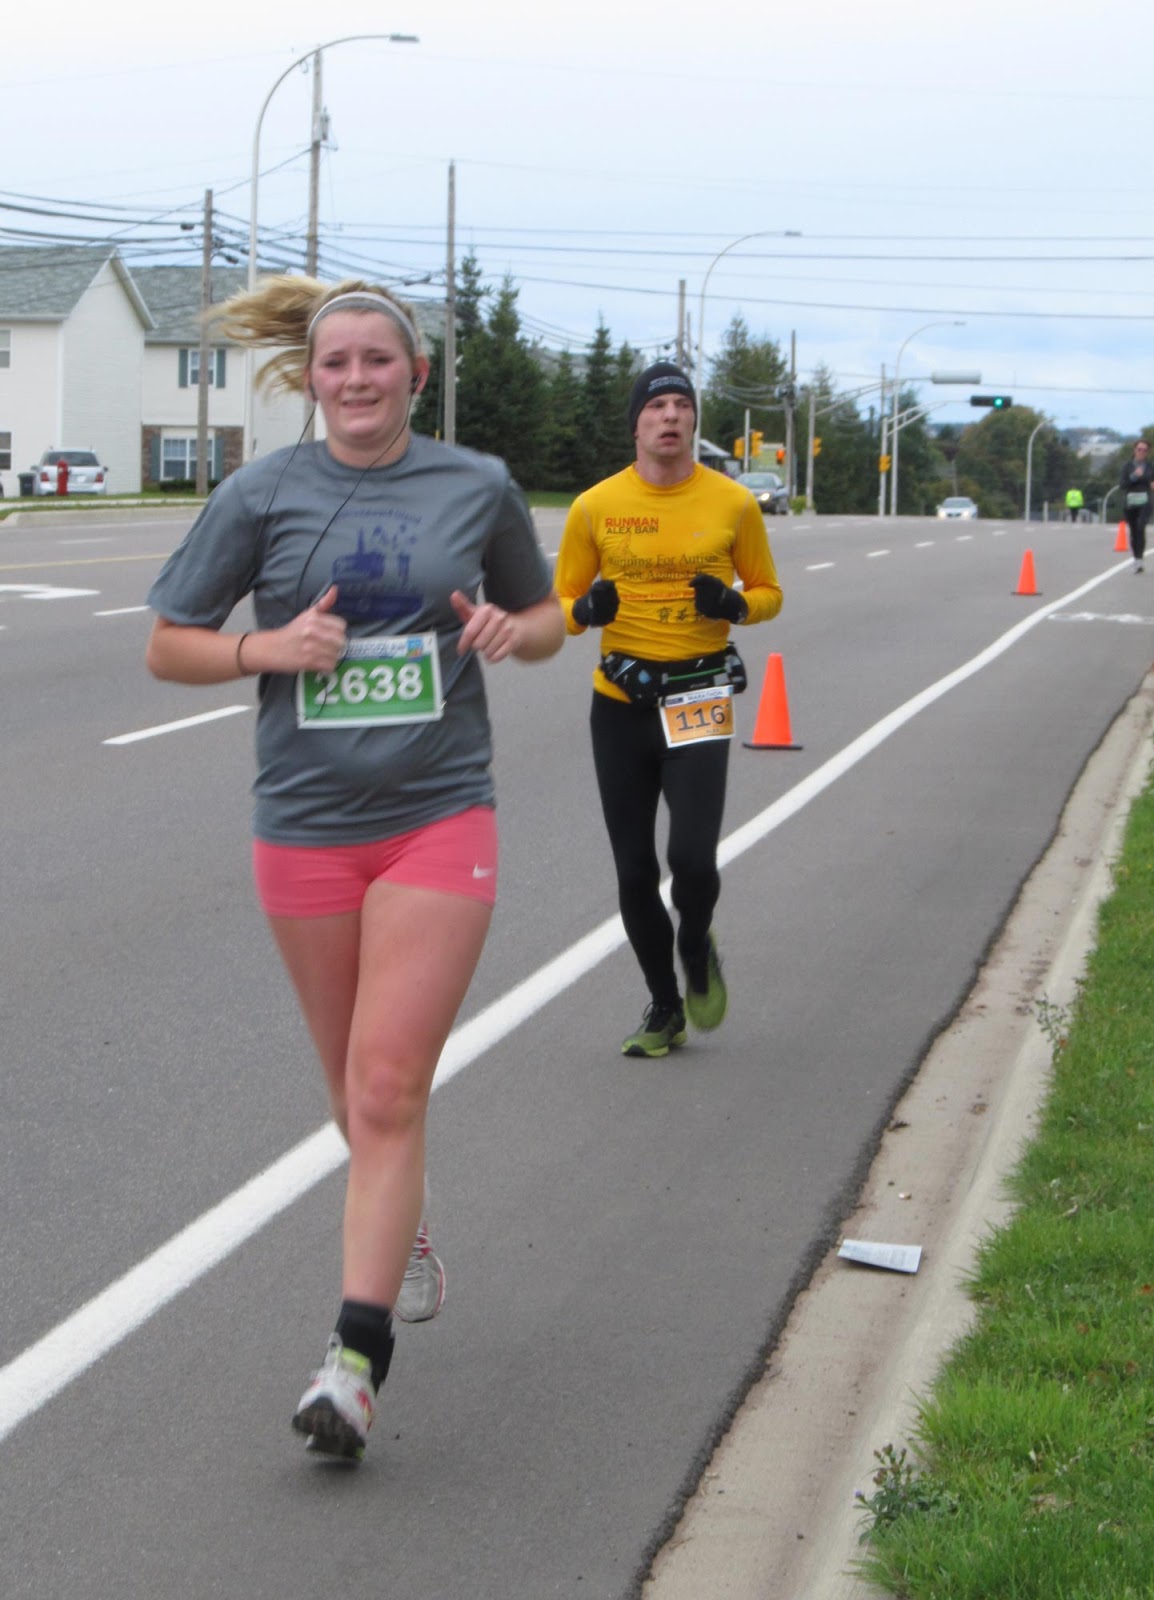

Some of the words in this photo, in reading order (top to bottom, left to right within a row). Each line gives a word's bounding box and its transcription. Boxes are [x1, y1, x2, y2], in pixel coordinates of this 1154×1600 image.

[605, 518, 659, 528] RUNMAN
[606, 527, 631, 535] ALEX
[635, 525, 658, 534] BAIN
[656, 554, 676, 566] For
[679, 553, 719, 565] Autism
[314, 663, 424, 705] 2638
[675, 705, 726, 731] 116
